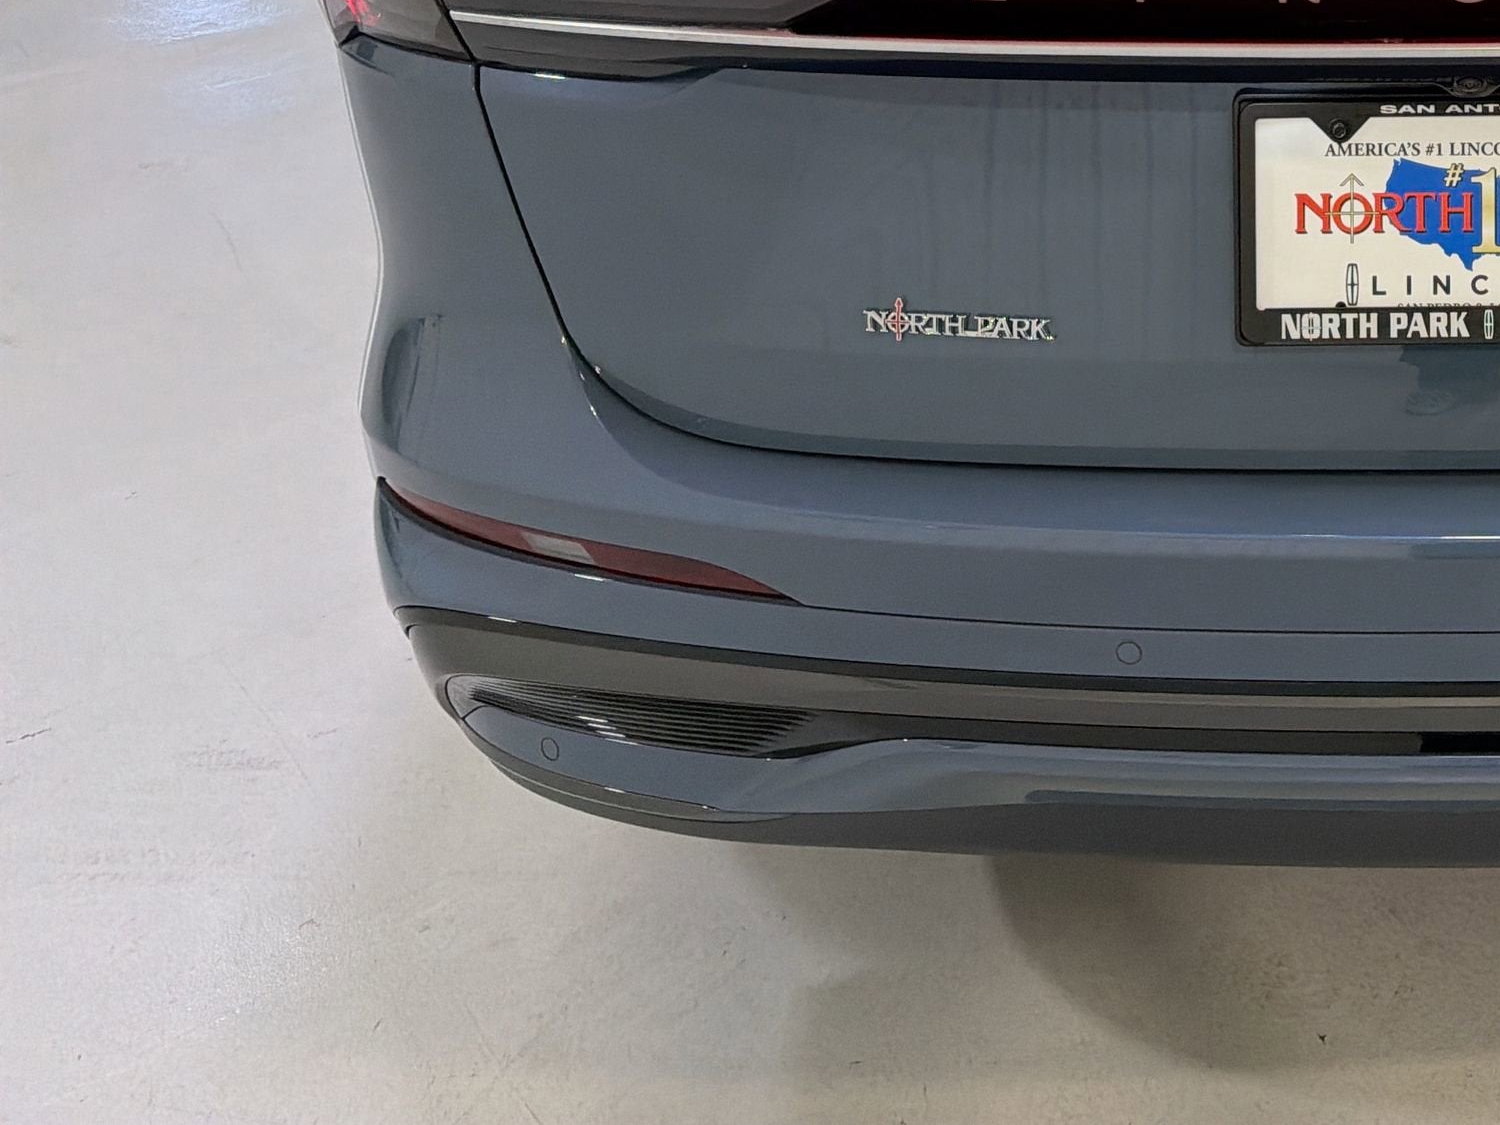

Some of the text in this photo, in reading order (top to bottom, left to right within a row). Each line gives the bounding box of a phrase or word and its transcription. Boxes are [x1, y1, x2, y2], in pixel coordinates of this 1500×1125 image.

[1380, 103, 1435, 114] SAN
[1325, 141, 1421, 157] AMERICA'S
[1425, 142, 1443, 156] #1
[1295, 192, 1474, 235] NORTH
[863, 309, 1055, 341] NORTH PARK
[1281, 312, 1470, 340] NORTH PARK
